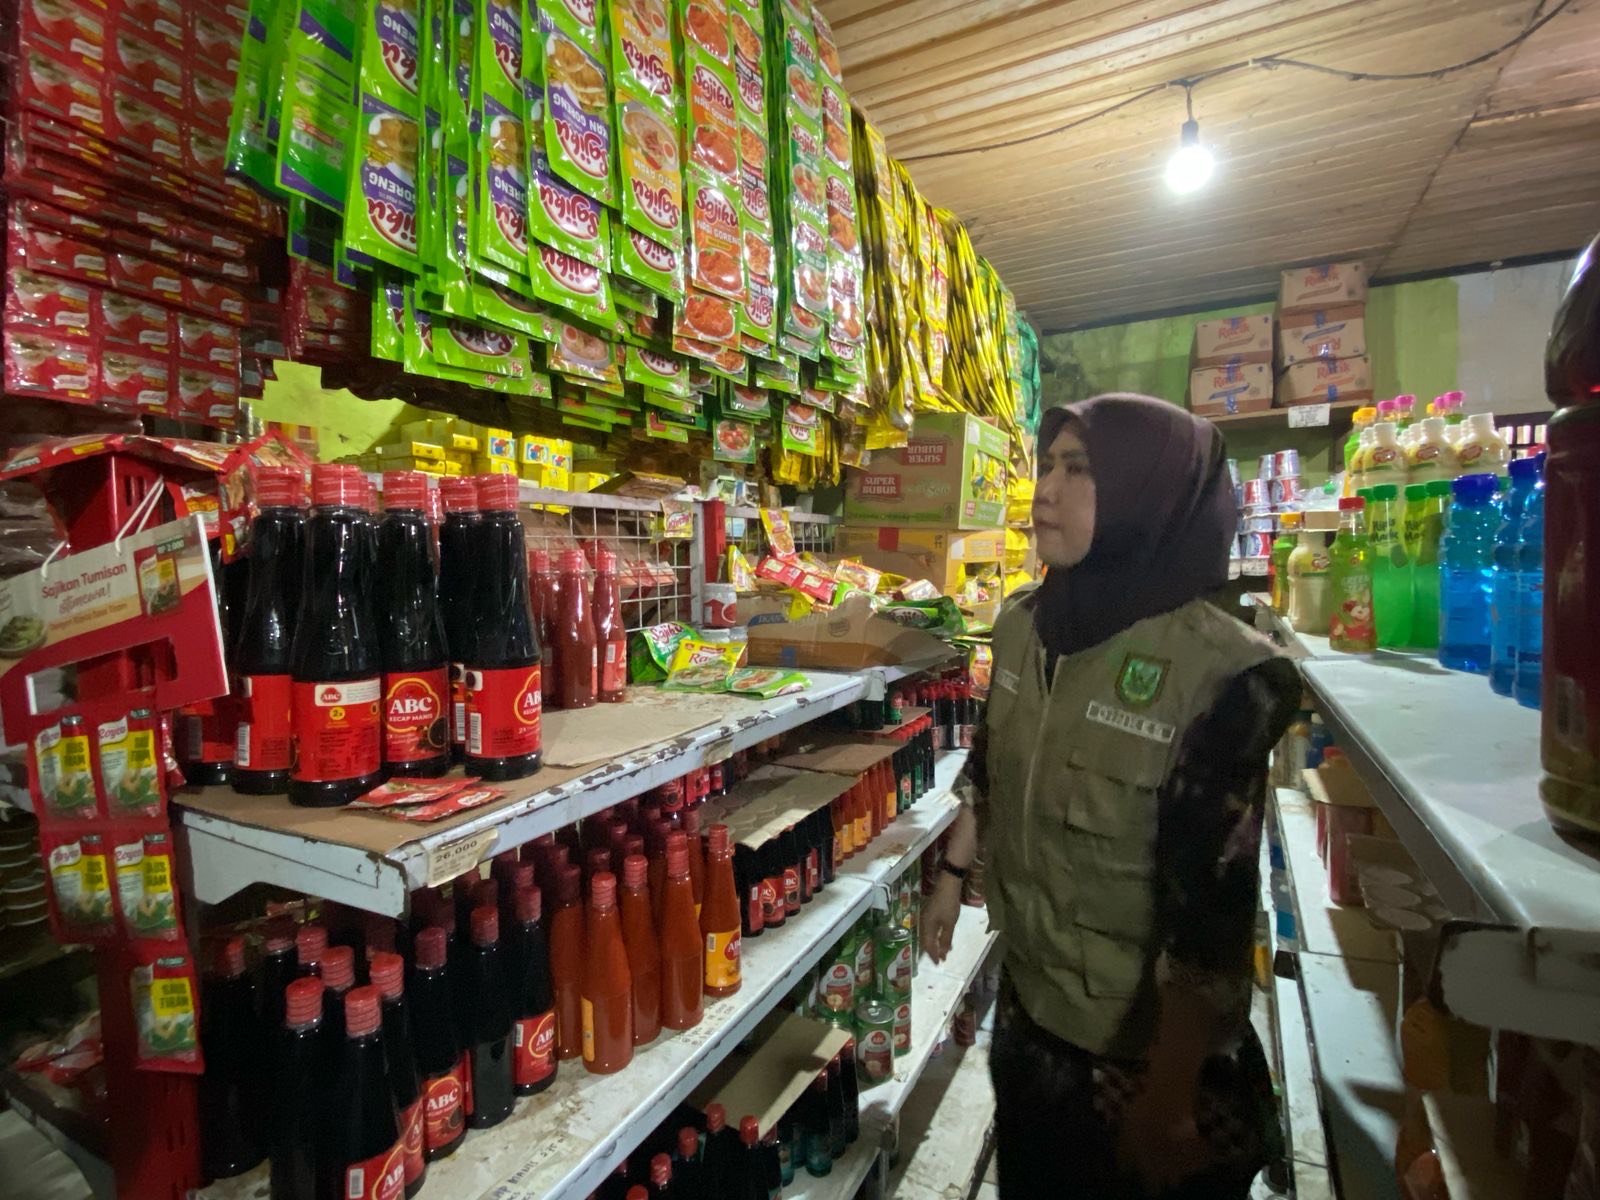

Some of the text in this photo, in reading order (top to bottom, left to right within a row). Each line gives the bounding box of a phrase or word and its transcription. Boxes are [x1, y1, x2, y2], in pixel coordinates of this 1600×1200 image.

[621, 38, 673, 94] Sajiku
[692, 65, 734, 110] Sajiku
[552, 92, 588, 127] GORENG
[554, 118, 608, 177] Sajiku
[368, 172, 416, 204] ORENG
[631, 178, 680, 228] Sajiku
[367, 197, 417, 245] jiku
[539, 184, 600, 238] Sajiku
[695, 188, 738, 227] Sajiku
[861, 485, 897, 495] BUBUR
[864, 476, 896, 486] SUPER
[42, 563, 127, 600] Sajikan Tumisan
[649, 623, 684, 645] Sajiku
[388, 697, 433, 714] ABC
[523, 688, 541, 709] AB
[389, 715, 411, 723] KECAP
[536, 1026, 554, 1046] AB
[427, 1087, 459, 1111] ABC
[382, 1165, 404, 1192] AB
